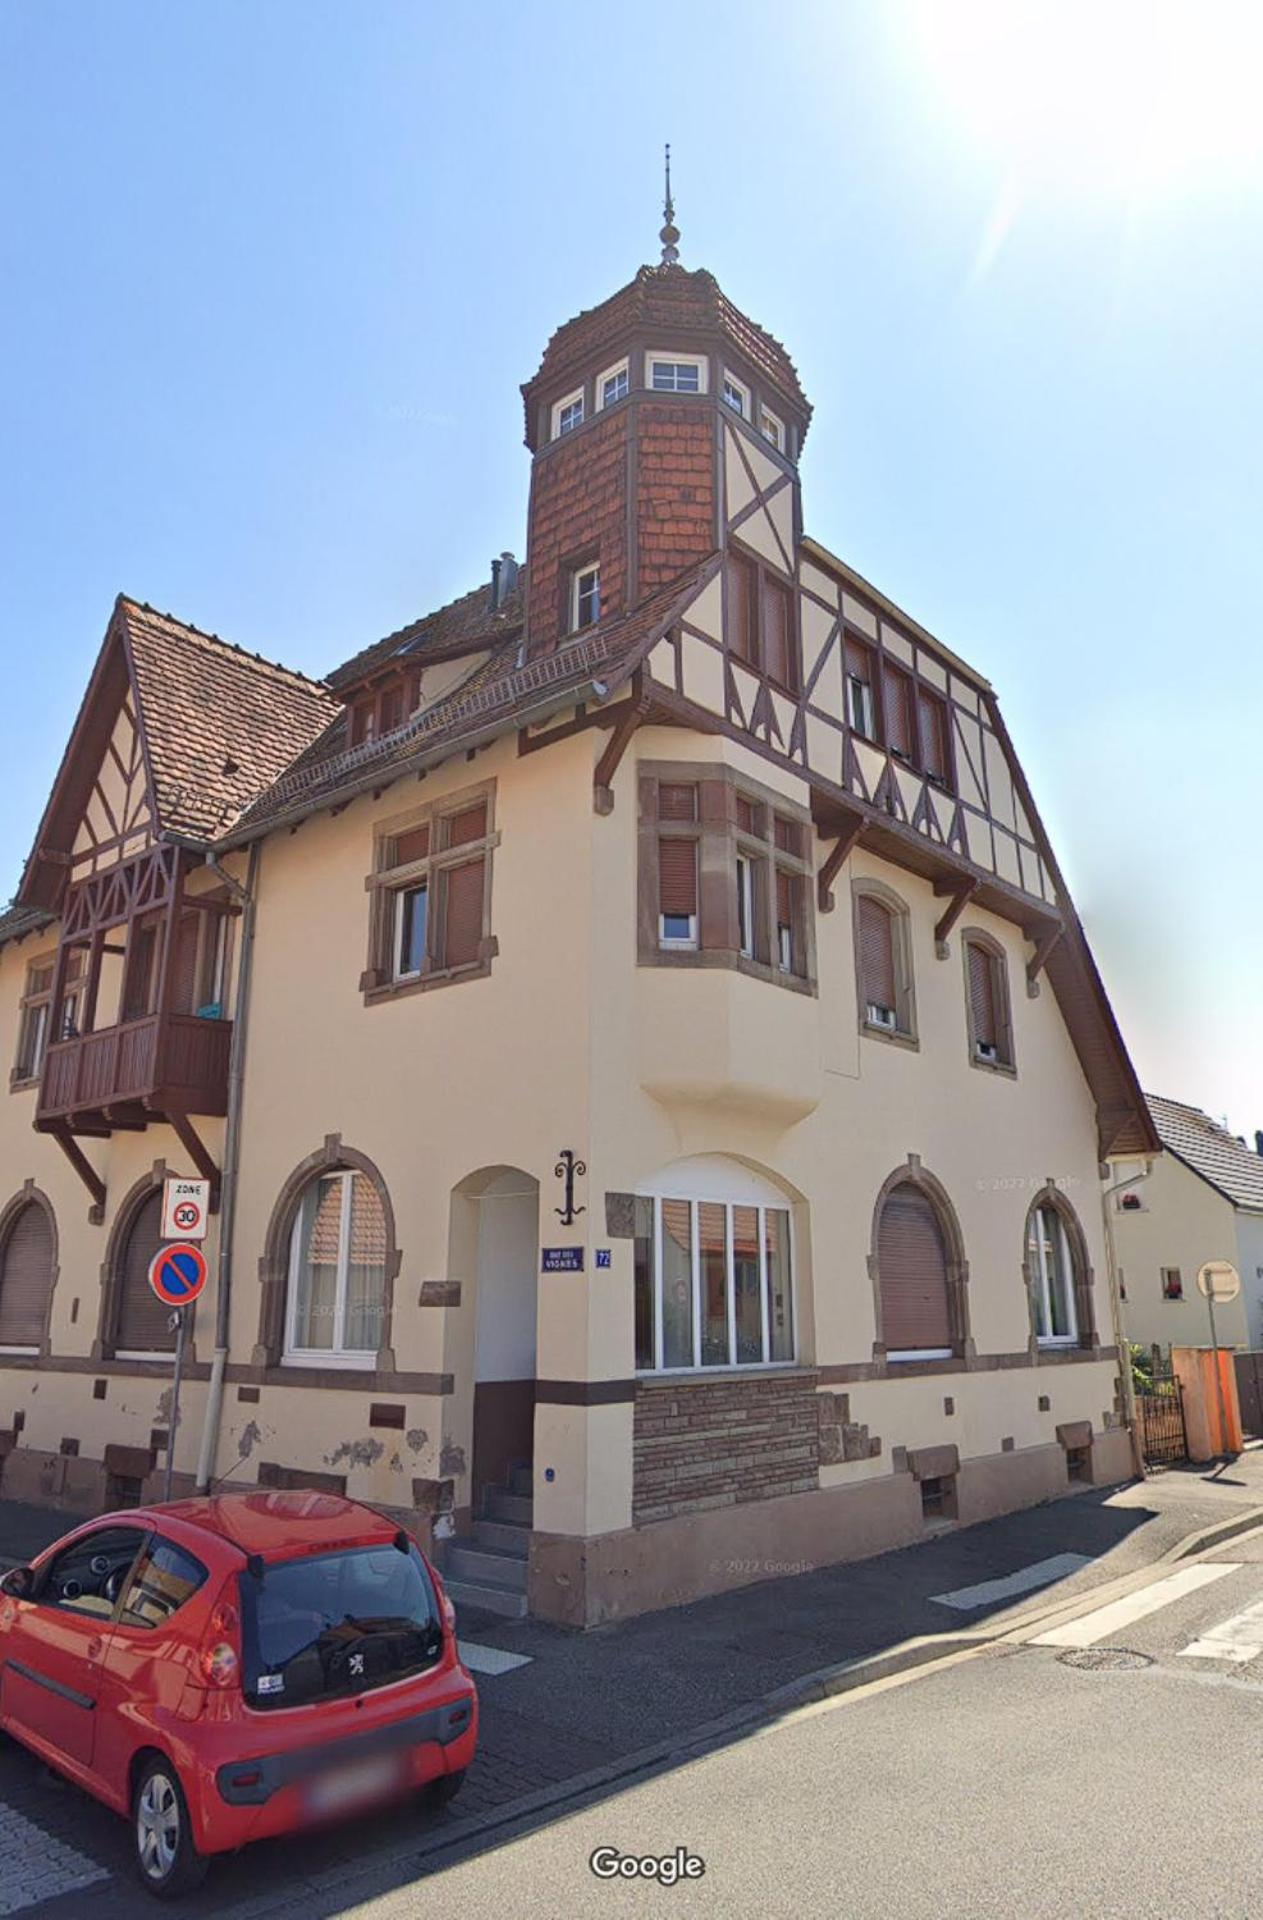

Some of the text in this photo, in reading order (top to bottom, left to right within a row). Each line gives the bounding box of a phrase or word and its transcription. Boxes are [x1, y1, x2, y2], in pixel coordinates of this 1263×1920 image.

[176, 1184, 202, 1196] ZONE
[178, 1209, 196, 1222] 30
[599, 1252, 610, 1265] 72
